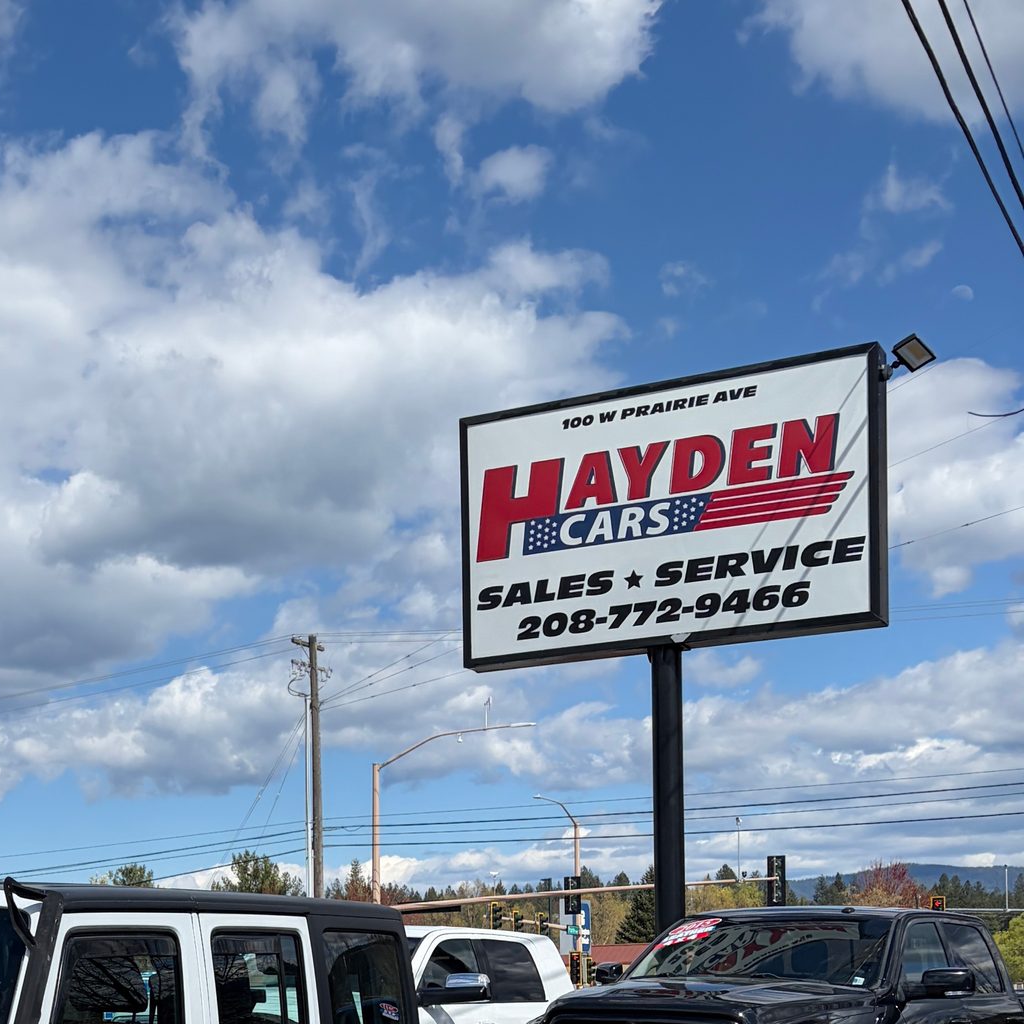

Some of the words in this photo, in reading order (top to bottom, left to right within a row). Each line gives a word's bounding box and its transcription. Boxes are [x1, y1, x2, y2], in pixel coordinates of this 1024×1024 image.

[561, 415, 594, 430] 100
[599, 410, 617, 424] W
[620, 394, 709, 420] PRAIRIE
[712, 385, 757, 404] AVE
[476, 413, 840, 563] HAYDEN
[559, 502, 671, 546] CARS
[477, 570, 615, 611] SALES
[654, 536, 866, 587] SERVICE
[517, 581, 811, 641] 208-772-9466
